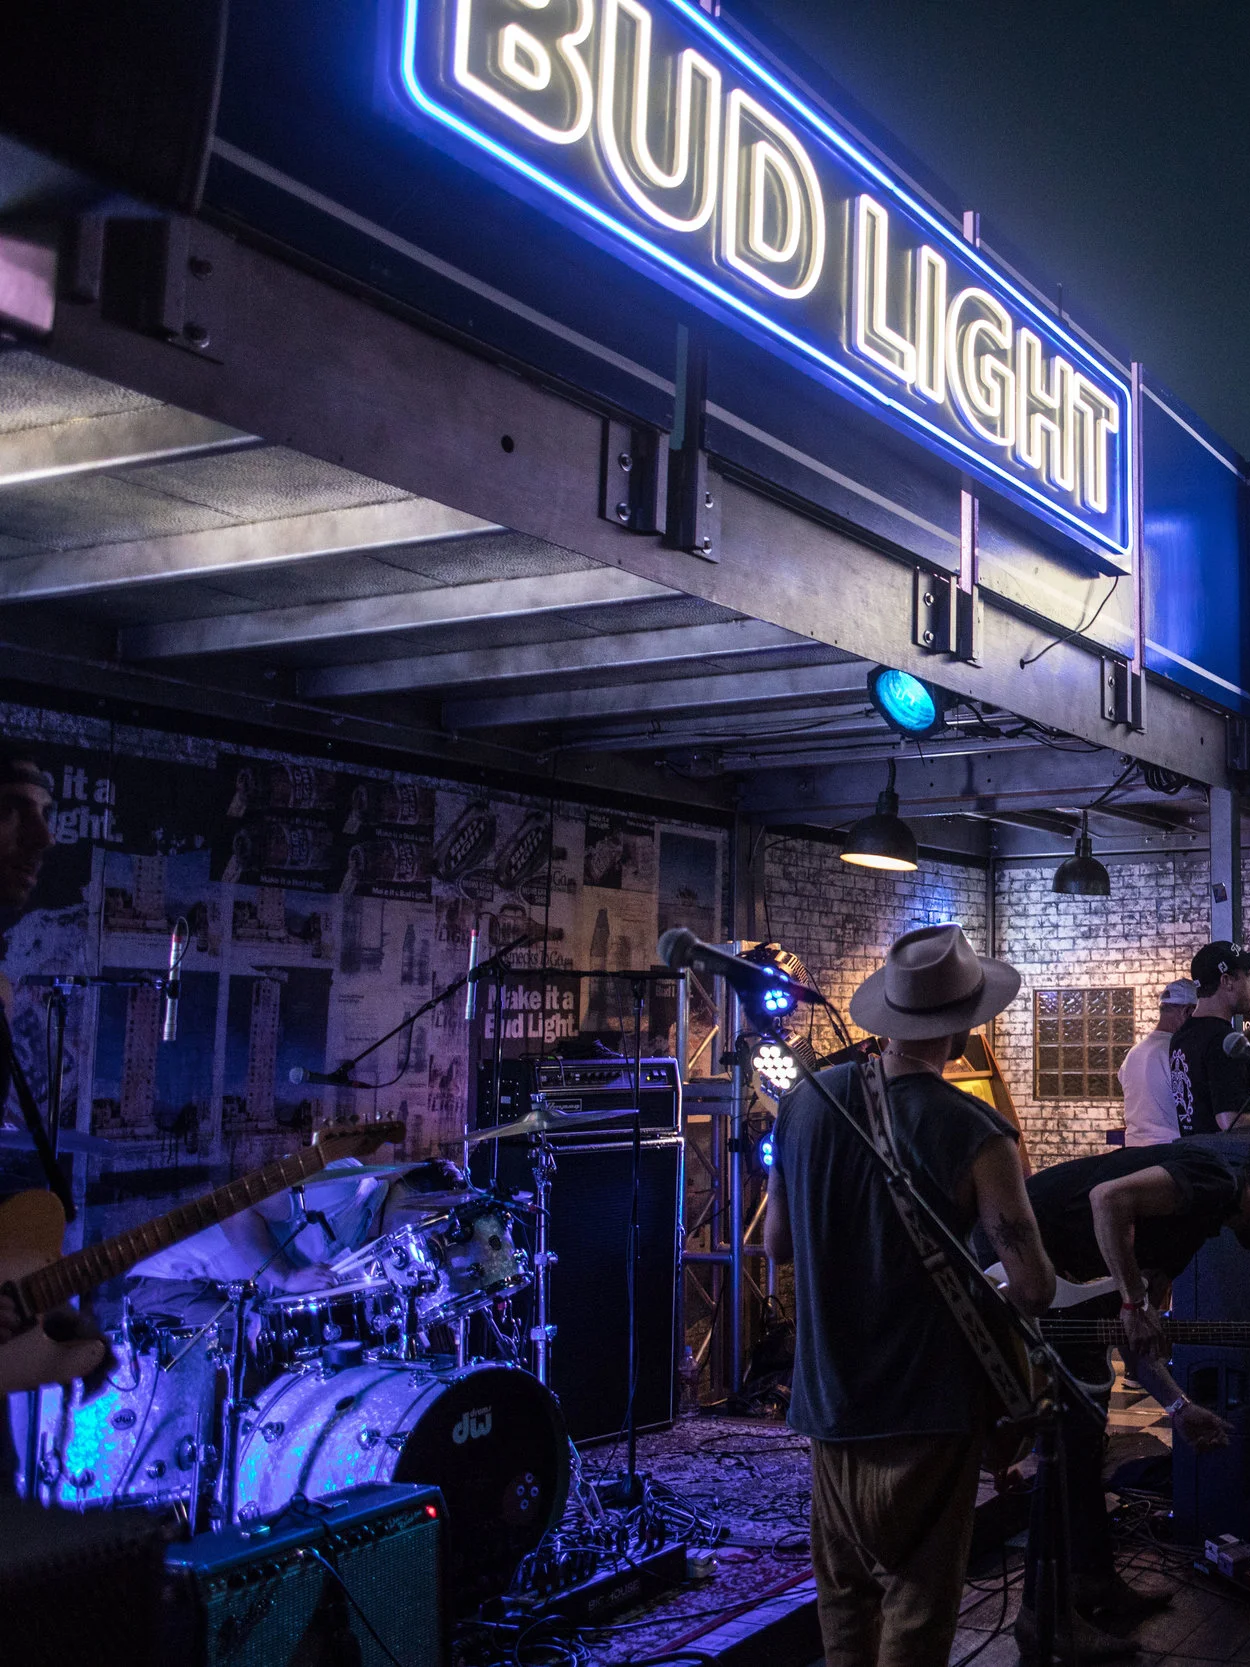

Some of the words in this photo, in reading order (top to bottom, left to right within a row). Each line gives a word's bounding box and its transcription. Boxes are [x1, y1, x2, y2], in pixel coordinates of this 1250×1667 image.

[453, 0, 826, 300] BUD
[855, 193, 1121, 515] LIGHT
[62, 764, 88, 801] it
[93, 777, 116, 806] a
[47, 801, 124, 844] ight.
[488, 984, 542, 1010] Make
[545, 984, 560, 1010] it
[562, 990, 574, 1010] a
[485, 1012, 524, 1039] Bud
[527, 1012, 579, 1043] Light.
[452, 1411, 493, 1445] dw
